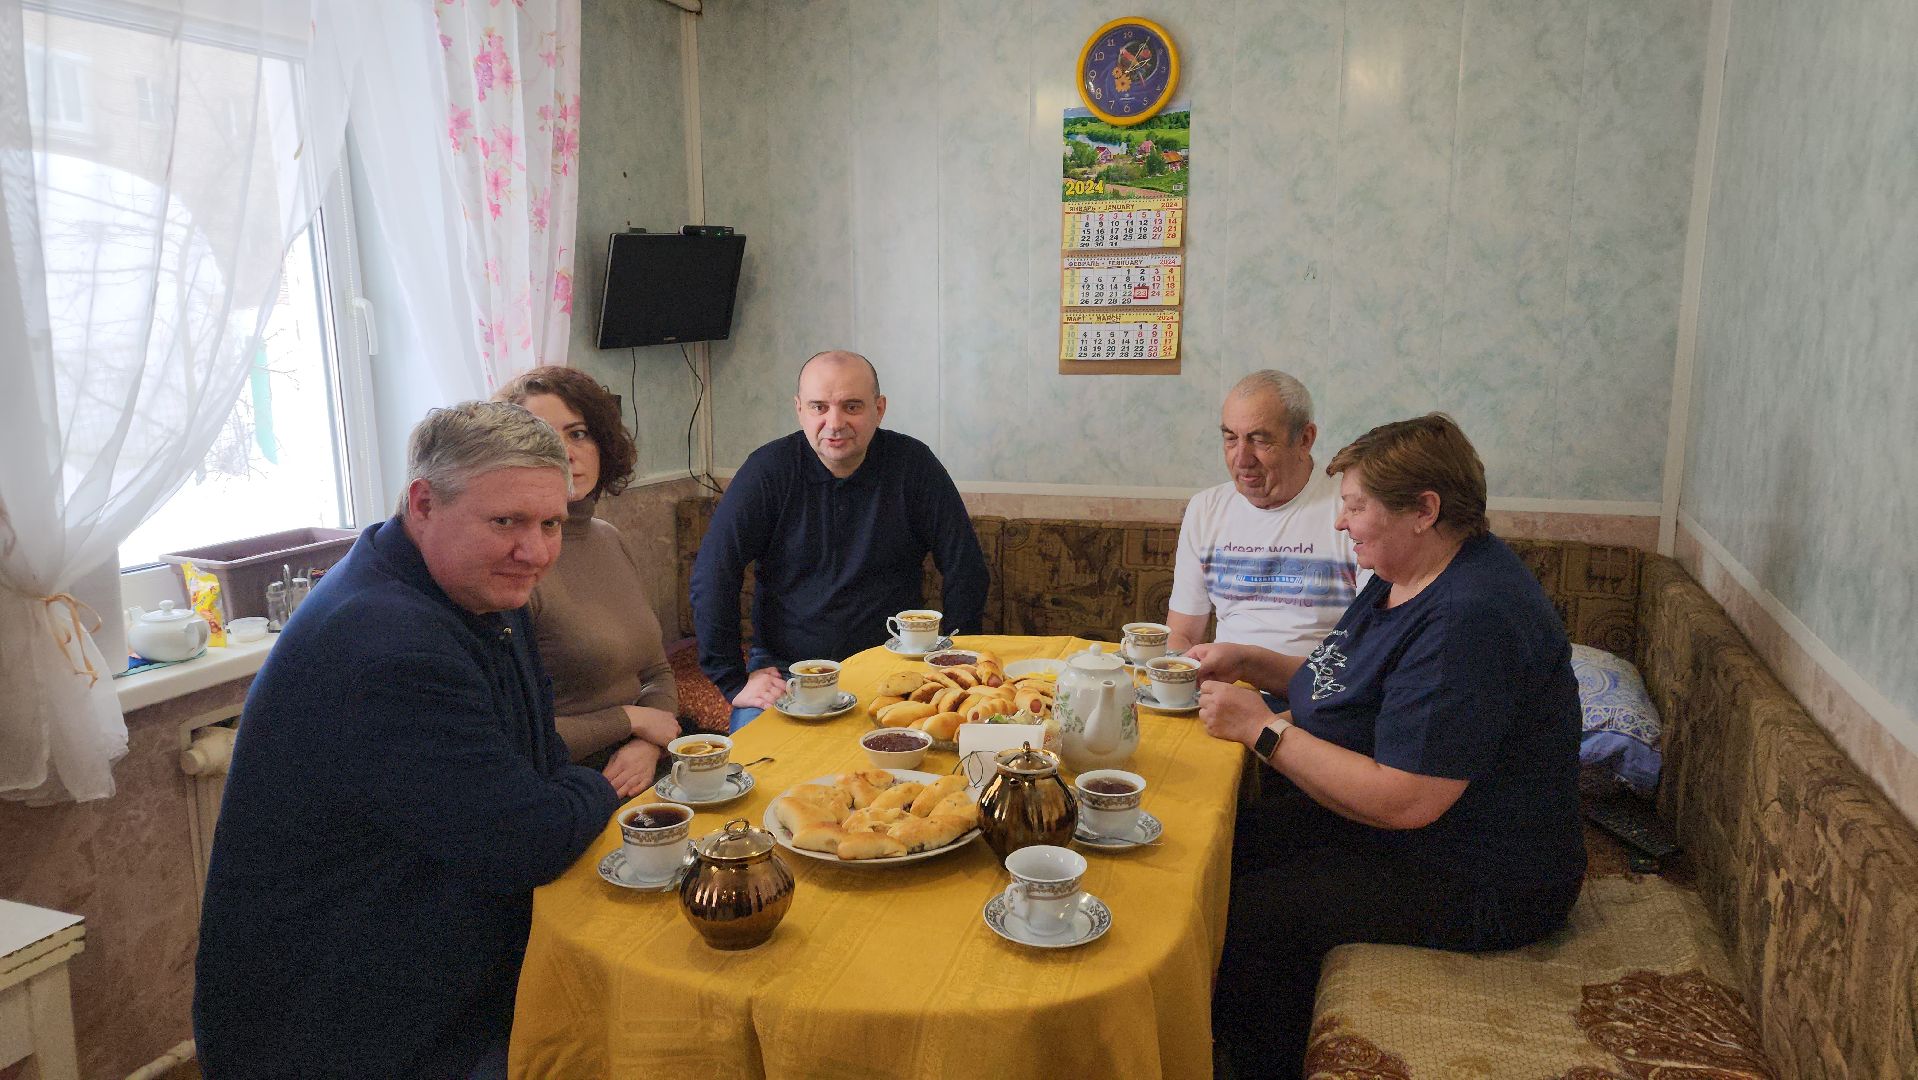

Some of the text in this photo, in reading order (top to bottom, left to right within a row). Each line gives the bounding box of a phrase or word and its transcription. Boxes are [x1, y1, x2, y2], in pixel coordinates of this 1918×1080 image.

[1095, 52, 1104, 61] 10
[1089, 70, 1096, 81] 9
[1096, 88, 1102, 99] 8
[1109, 101, 1114, 109] 7
[1143, 97, 1149, 105] 5
[1124, 104, 1130, 112] 6
[1066, 180, 1104, 195] 2024
[1224, 542, 1314, 554] dream world
